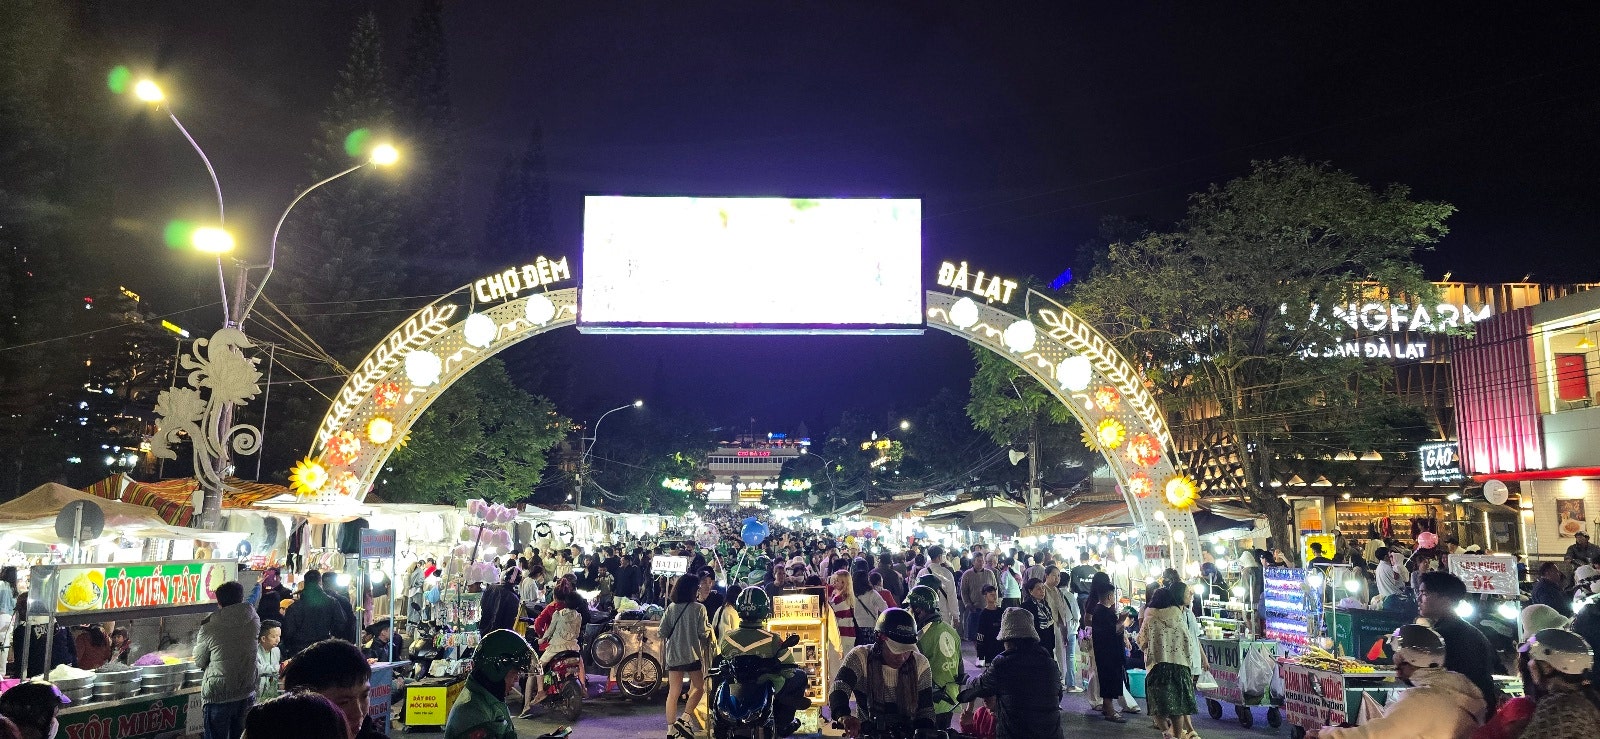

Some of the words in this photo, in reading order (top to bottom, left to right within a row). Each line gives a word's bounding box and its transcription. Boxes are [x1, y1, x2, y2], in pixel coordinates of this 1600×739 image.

[475, 267, 520, 302] CHỢ
[521, 255, 571, 289] ĐÊM
[937, 261, 968, 291] ĐÀ
[972, 271, 1018, 304] LẠT
[1280, 302, 1490, 332] NGFARM
[1364, 338, 1392, 359] ĐÀ
[1395, 343, 1427, 361] LẠT
[1426, 448, 1453, 469] GẠO
[104, 568, 133, 610] XÔI
[170, 566, 200, 603] TÂY
[1304, 695, 1321, 706] LANG
[65, 714, 112, 739] XÔI
